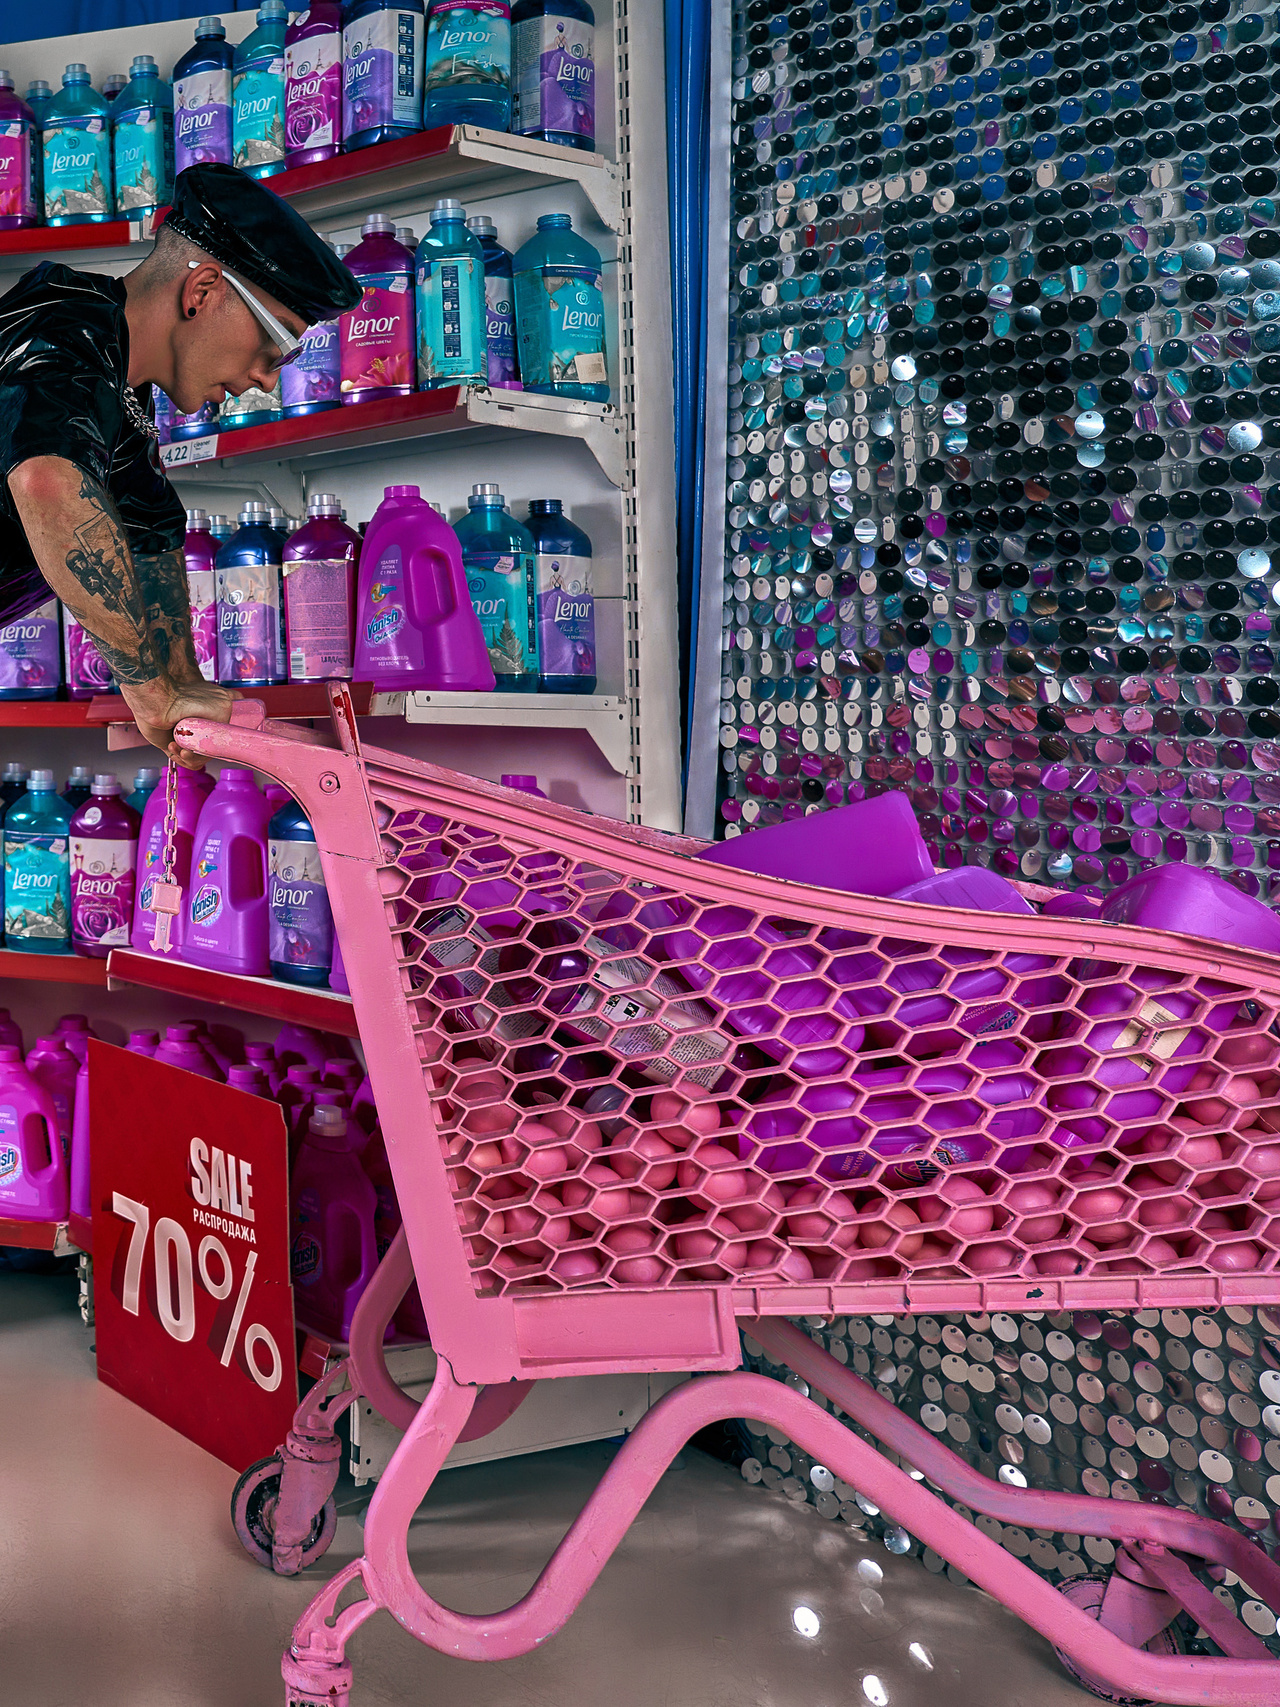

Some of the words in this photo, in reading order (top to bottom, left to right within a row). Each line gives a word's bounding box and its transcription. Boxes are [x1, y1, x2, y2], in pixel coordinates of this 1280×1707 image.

[440, 30, 496, 50] Lenor
[344, 55, 376, 90] Lenor
[452, 51, 501, 74] Fresh
[557, 57, 593, 83] Lenor
[288, 76, 326, 105] Lenor
[237, 93, 276, 125] Lenor
[179, 108, 218, 138] Lenor
[52, 152, 95, 174] Lenor
[348, 312, 400, 342] Lenor
[561, 304, 602, 330] Lenor
[219, 608, 258, 631] Lenor
[555, 596, 592, 622] Lenor
[0, 622, 46, 644] Lenor
[367, 609, 398, 639] Vanish
[13, 869, 58, 890] Lenor
[74, 875, 122, 897] Lenor
[190, 884, 219, 923] Vanish
[272, 884, 314, 908] Lenor
[190, 1137, 256, 1222] SALE
[193, 1208, 257, 1244] РАСПРОДАЖА
[112, 1191, 282, 1392] 70%
